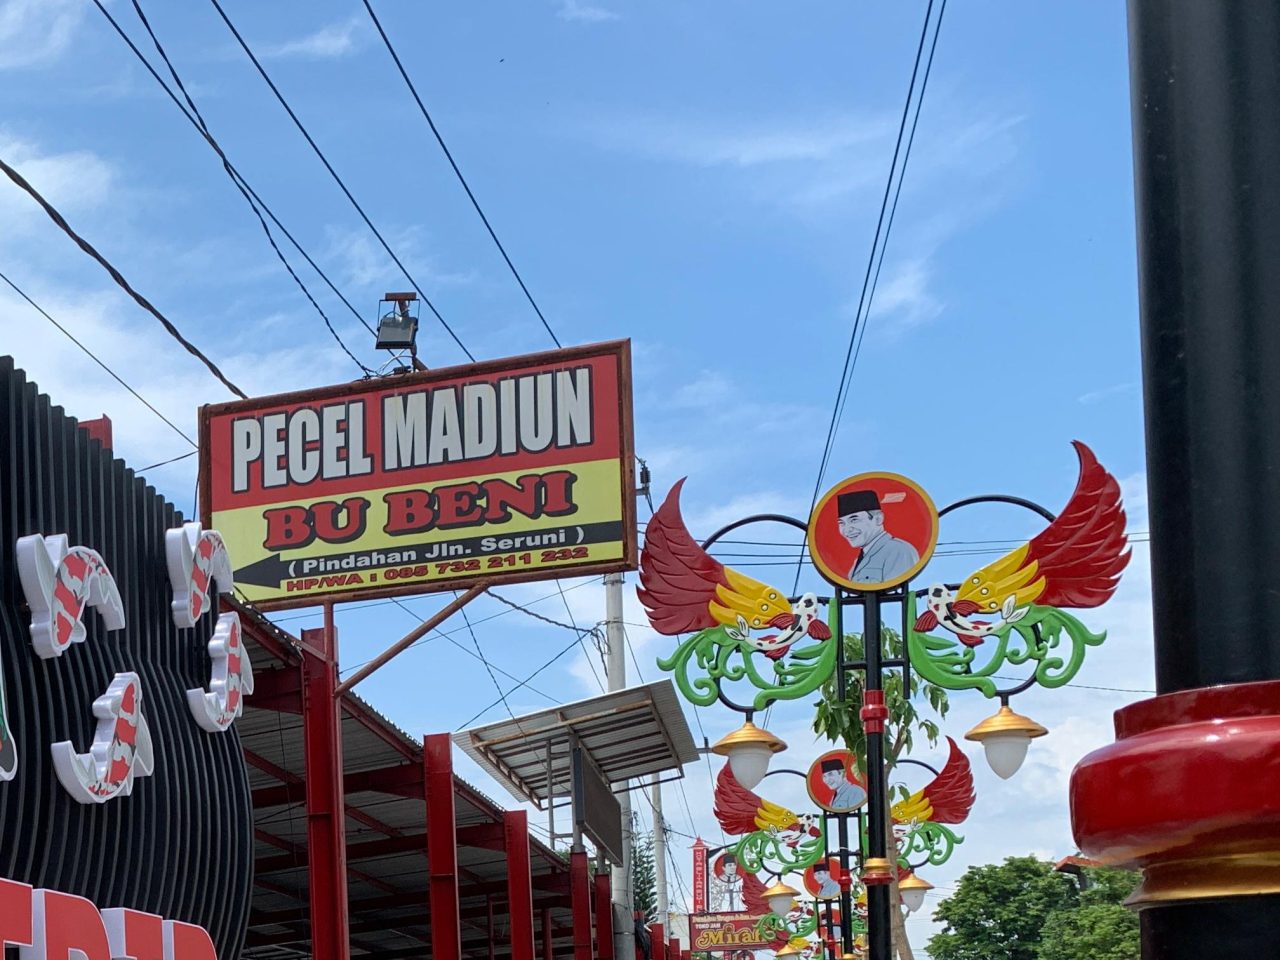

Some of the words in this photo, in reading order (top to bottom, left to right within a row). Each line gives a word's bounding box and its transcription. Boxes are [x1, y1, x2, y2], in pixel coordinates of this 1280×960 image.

[232, 400, 373, 493] PECEL
[382, 366, 592, 471] MADIUN
[263, 497, 371, 551] BU
[383, 470, 578, 537] BENI
[286, 571, 365, 592] HP/WA
[384, 563, 429, 581] 085
[435, 557, 481, 575] 732
[487, 553, 531, 569] 211
[541, 546, 589, 563] 232
[425, 541, 471, 559] Jln.
